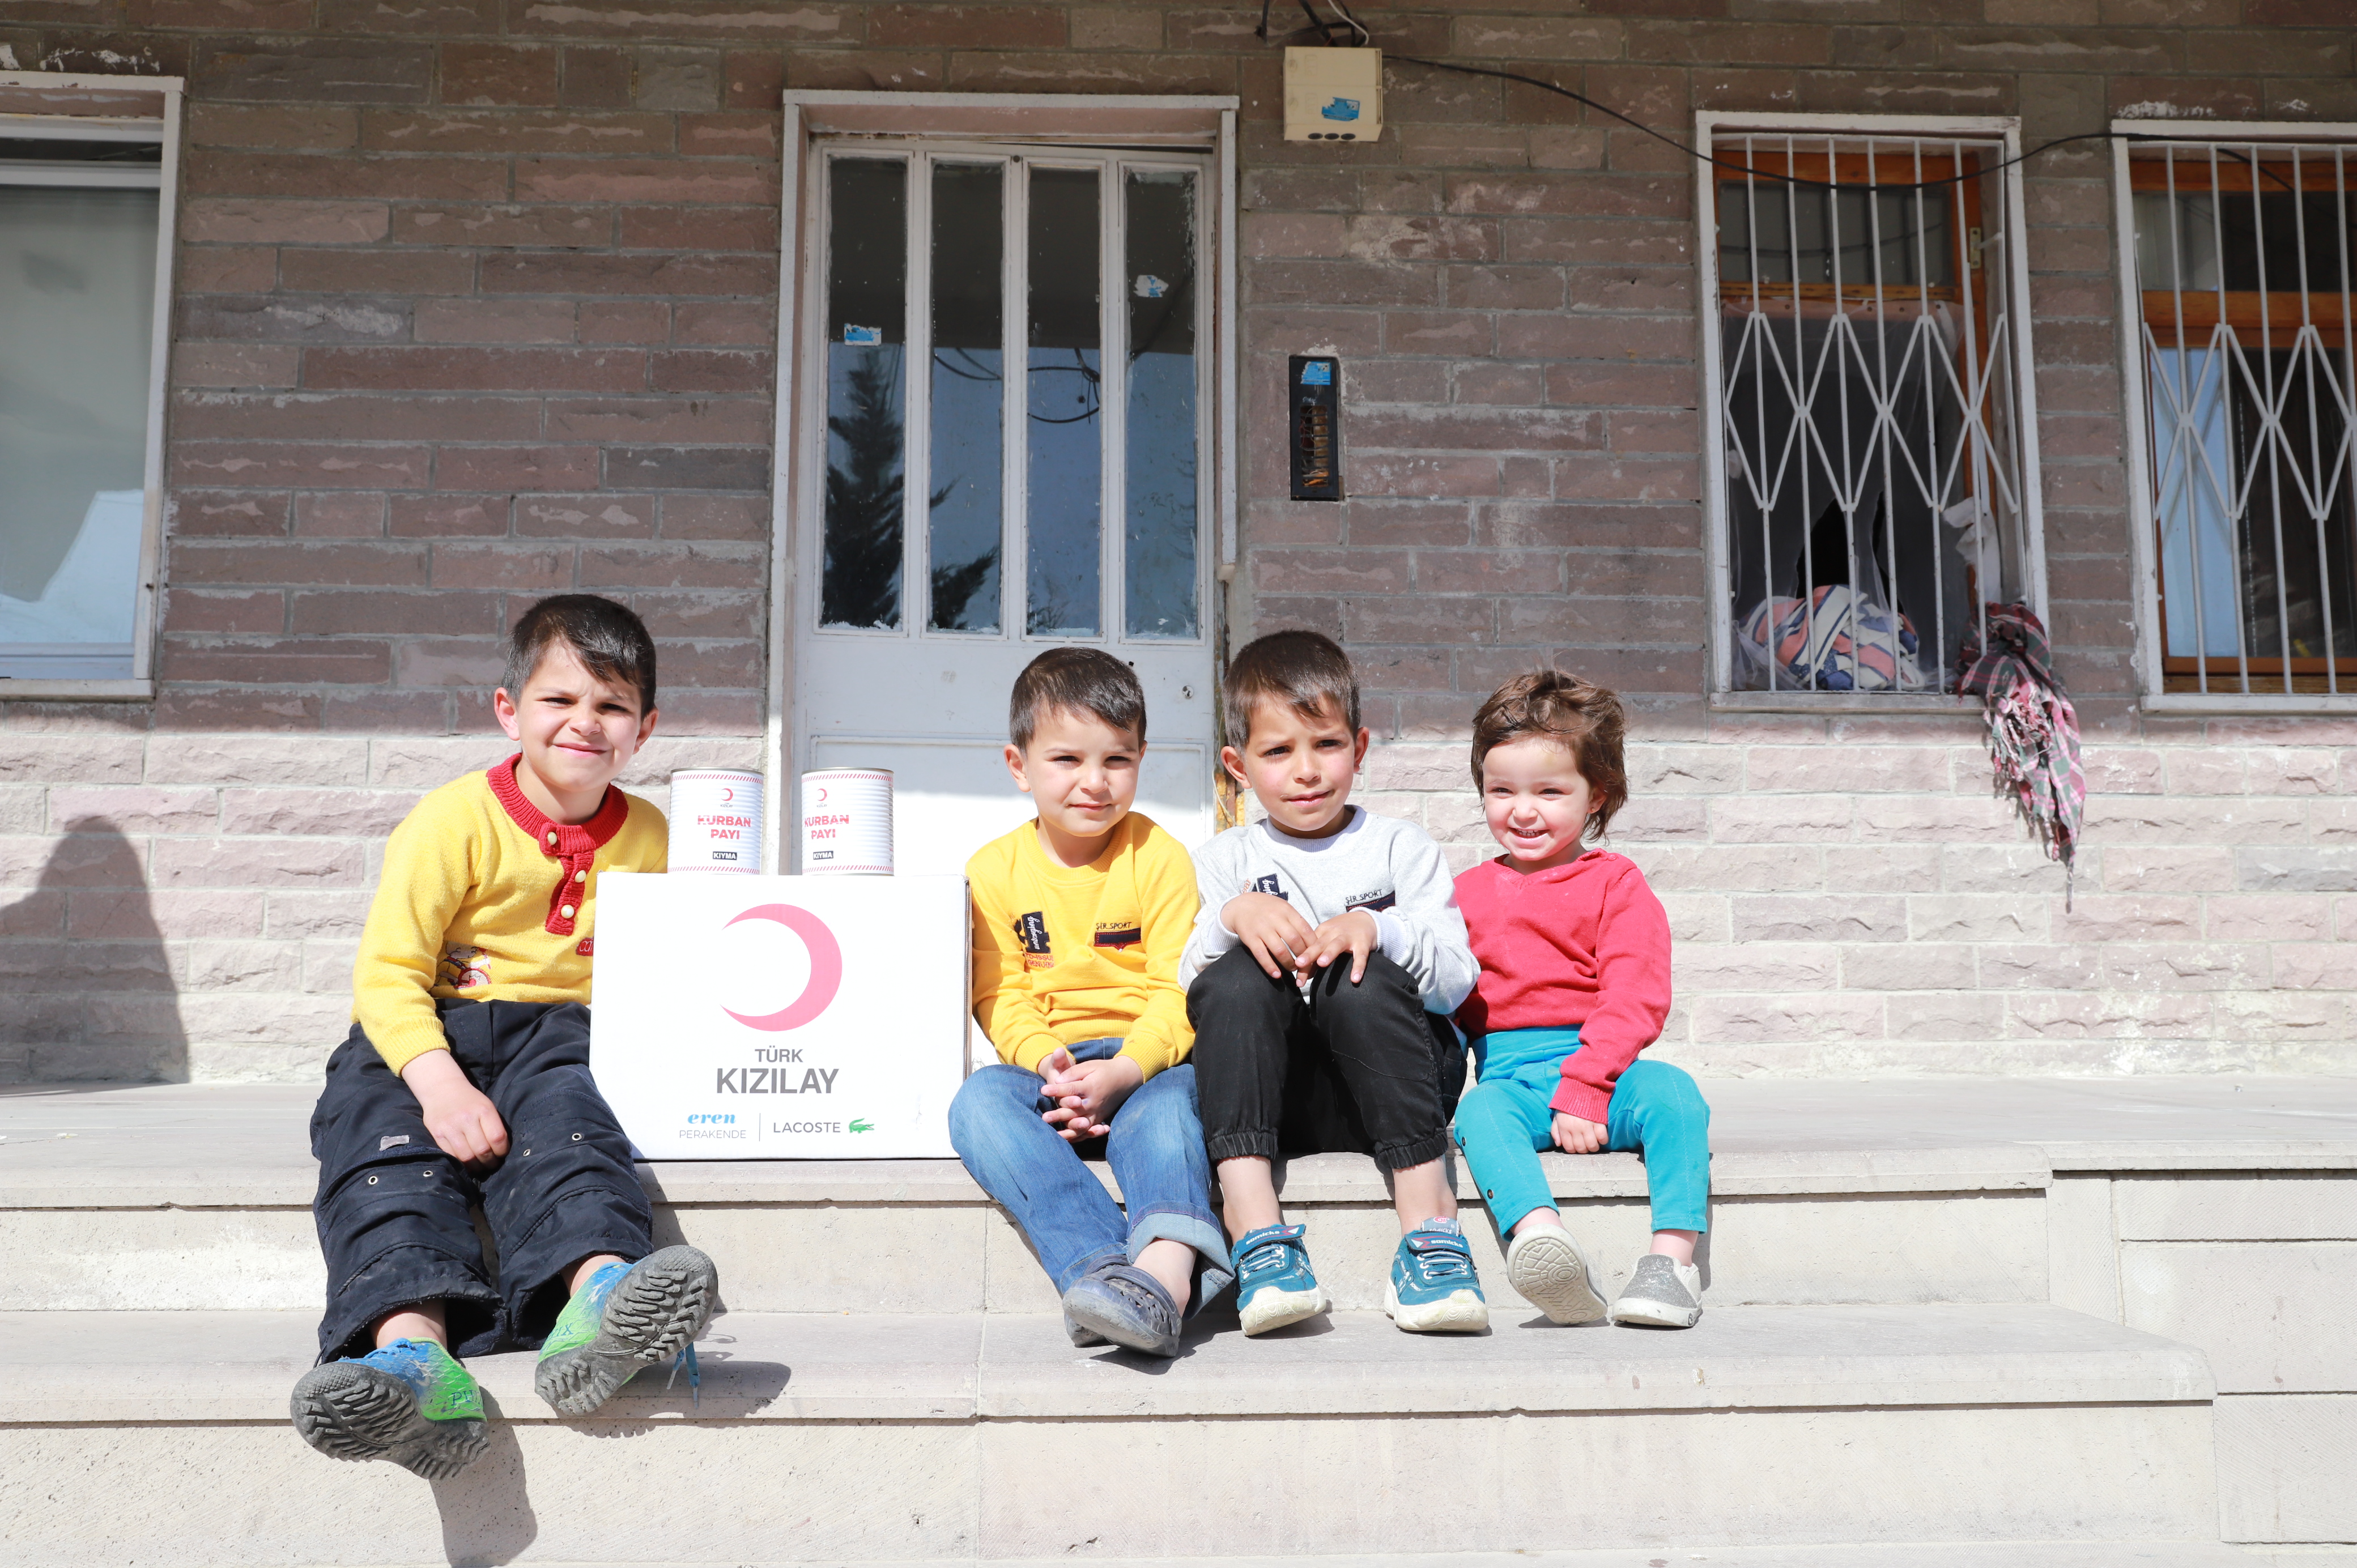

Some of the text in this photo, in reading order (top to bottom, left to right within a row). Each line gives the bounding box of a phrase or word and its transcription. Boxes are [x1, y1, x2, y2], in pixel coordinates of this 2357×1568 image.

[697, 815, 751, 828] KURBAN
[805, 815, 849, 828] KURBAN
[710, 829, 740, 840] PAYI
[811, 829, 836, 840] PAYI
[1360, 889, 1382, 901] SPORT
[755, 1045, 803, 1063] TÜRK
[717, 1068, 840, 1094] KIZILAY
[687, 1114, 736, 1124] eren
[773, 1122, 841, 1133] LACOSTE
[679, 1130, 746, 1139] PERAKENDE
[1245, 1230, 1280, 1245] somicks
[1431, 1239, 1463, 1248] somicks
